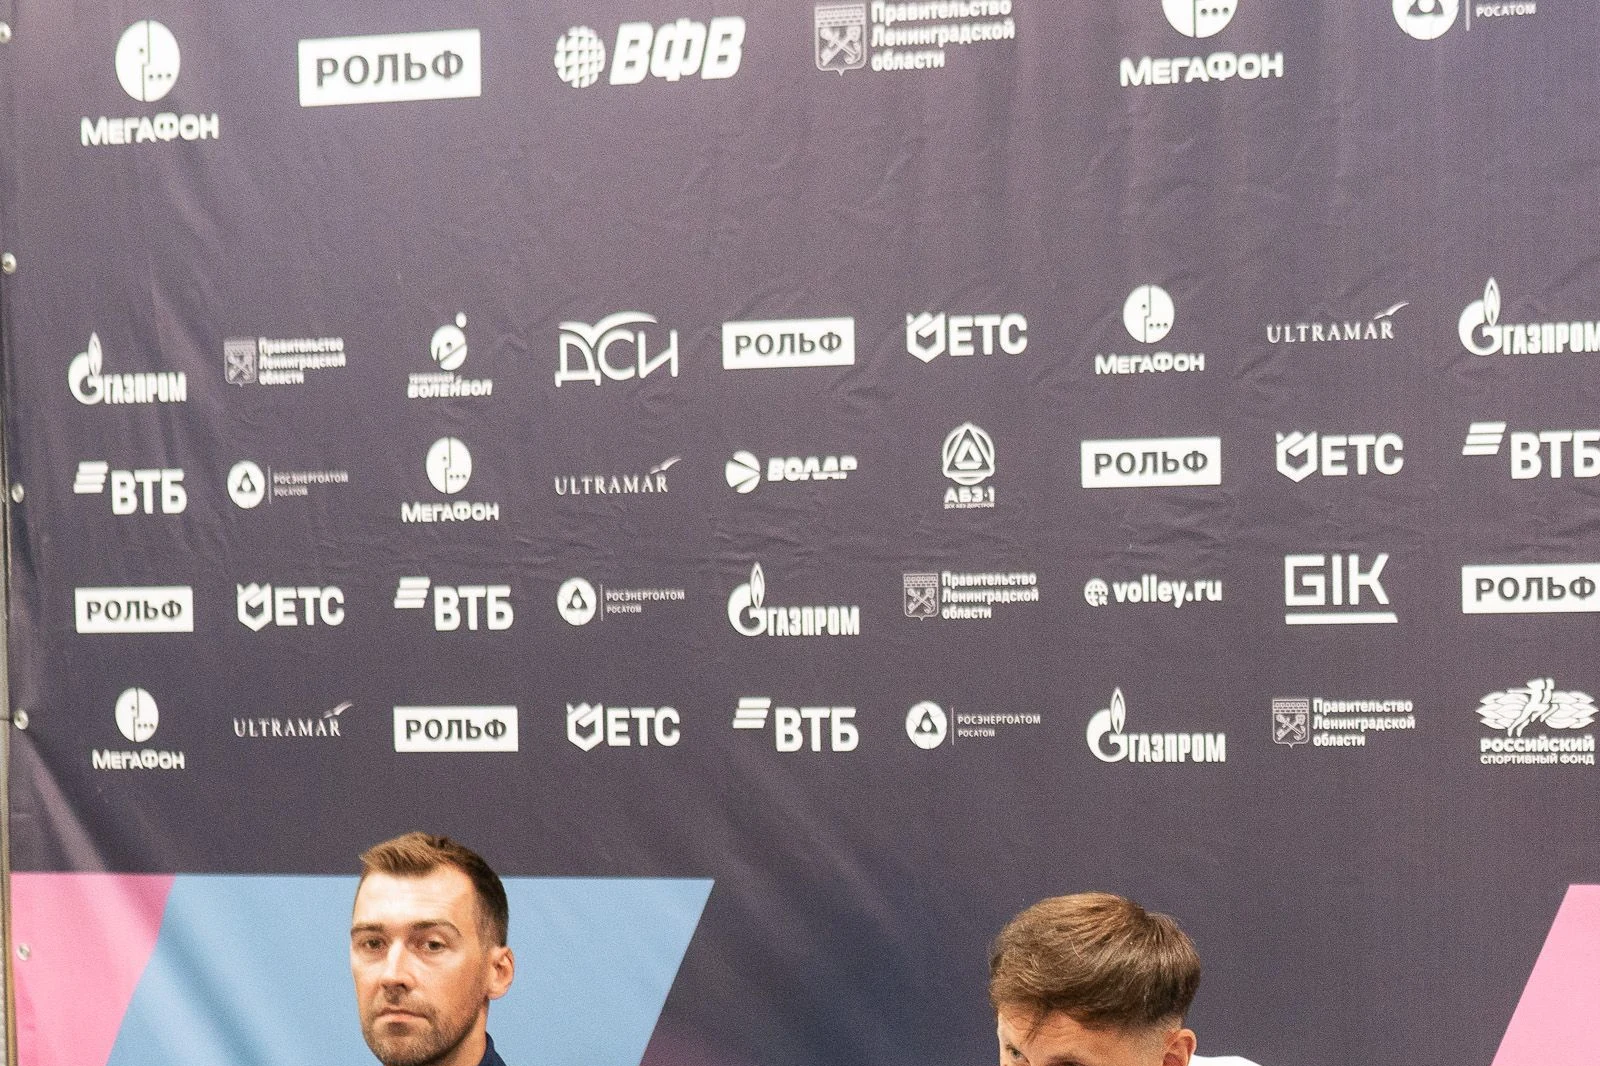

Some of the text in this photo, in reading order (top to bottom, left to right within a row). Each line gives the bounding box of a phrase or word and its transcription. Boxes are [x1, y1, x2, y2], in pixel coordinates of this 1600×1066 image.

[870, 0, 1012, 24] Правительство
[1475, 2, 1537, 18] РОСАТОМ
[870, 18, 1016, 48] Ленинградской
[609, 16, 746, 86] ВФВ
[870, 49, 945, 72] области
[316, 49, 464, 88] РОЛЬФ
[1266, 316, 1394, 344] ULTRAMAR
[258, 337, 344, 355] Правительство
[734, 331, 843, 357] РОЛЬФ
[258, 352, 347, 371] Ленинградской
[102, 371, 187, 405] ГАЗПРОМ
[258, 369, 304, 385] области
[1094, 450, 1209, 476] РОЛЬФ
[111, 468, 188, 515] ВТБ
[554, 474, 668, 496] ULTRAMAR
[941, 571, 1037, 589] Правительство
[1284, 553, 1390, 606] GIK
[1475, 575, 1596, 602] РОЛЬФ
[605, 589, 685, 602] РОСЭНЕРГОАТОМ
[941, 587, 1039, 605] Ленинградской
[1112, 574, 1223, 609] volley.ru
[86, 599, 183, 621] РОЛЬФ
[433, 585, 514, 631] ВТБ
[606, 605, 642, 614] РОСАТОМ
[941, 604, 992, 620] области
[765, 605, 860, 637] ГАЗПРОМ
[1312, 698, 1414, 716] Правительство
[233, 718, 341, 738] ULTRAMAR
[405, 718, 507, 741] РОЛЬФ
[775, 706, 860, 752] ВТБ
[957, 713, 1041, 725] РОСЭНЕРГОАТОМ
[1312, 714, 1416, 733] Ленинградской
[957, 728, 996, 738] РОСАТОМ
[1312, 732, 1366, 747] области
[1480, 734, 1595, 753] РОССИЙСКИЙ
[1126, 733, 1226, 763] ГАЗПРОМ
[1480, 752, 1595, 766] СПОРТИВНЫЙ ФОНД
